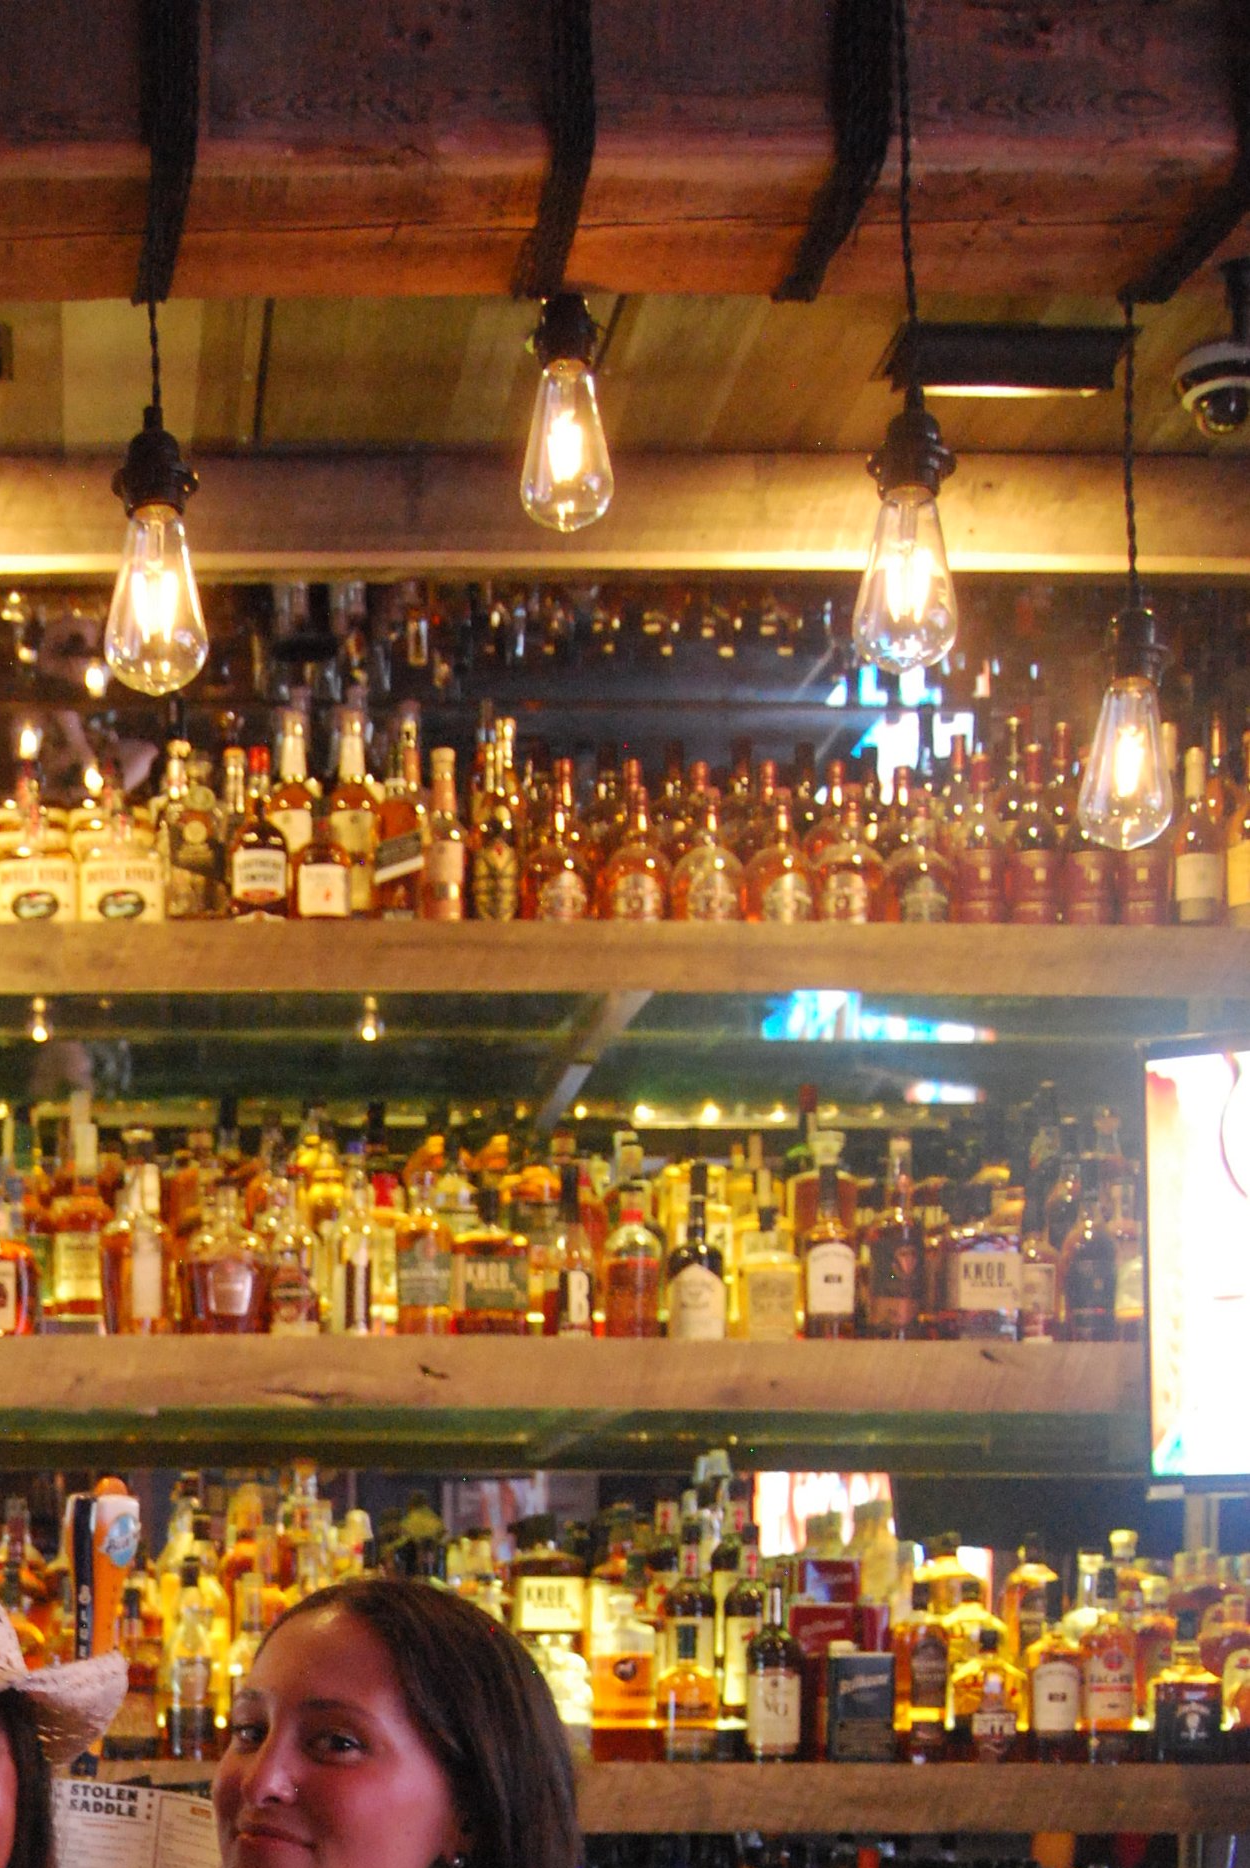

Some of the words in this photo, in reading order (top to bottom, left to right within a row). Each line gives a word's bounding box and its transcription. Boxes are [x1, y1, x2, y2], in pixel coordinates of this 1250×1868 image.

[963, 1262, 1006, 1280] KNOB
[525, 1585, 566, 1601] KNOB
[70, 1783, 138, 1803] STOLEN
[68, 1799, 138, 1818] SADDLE
